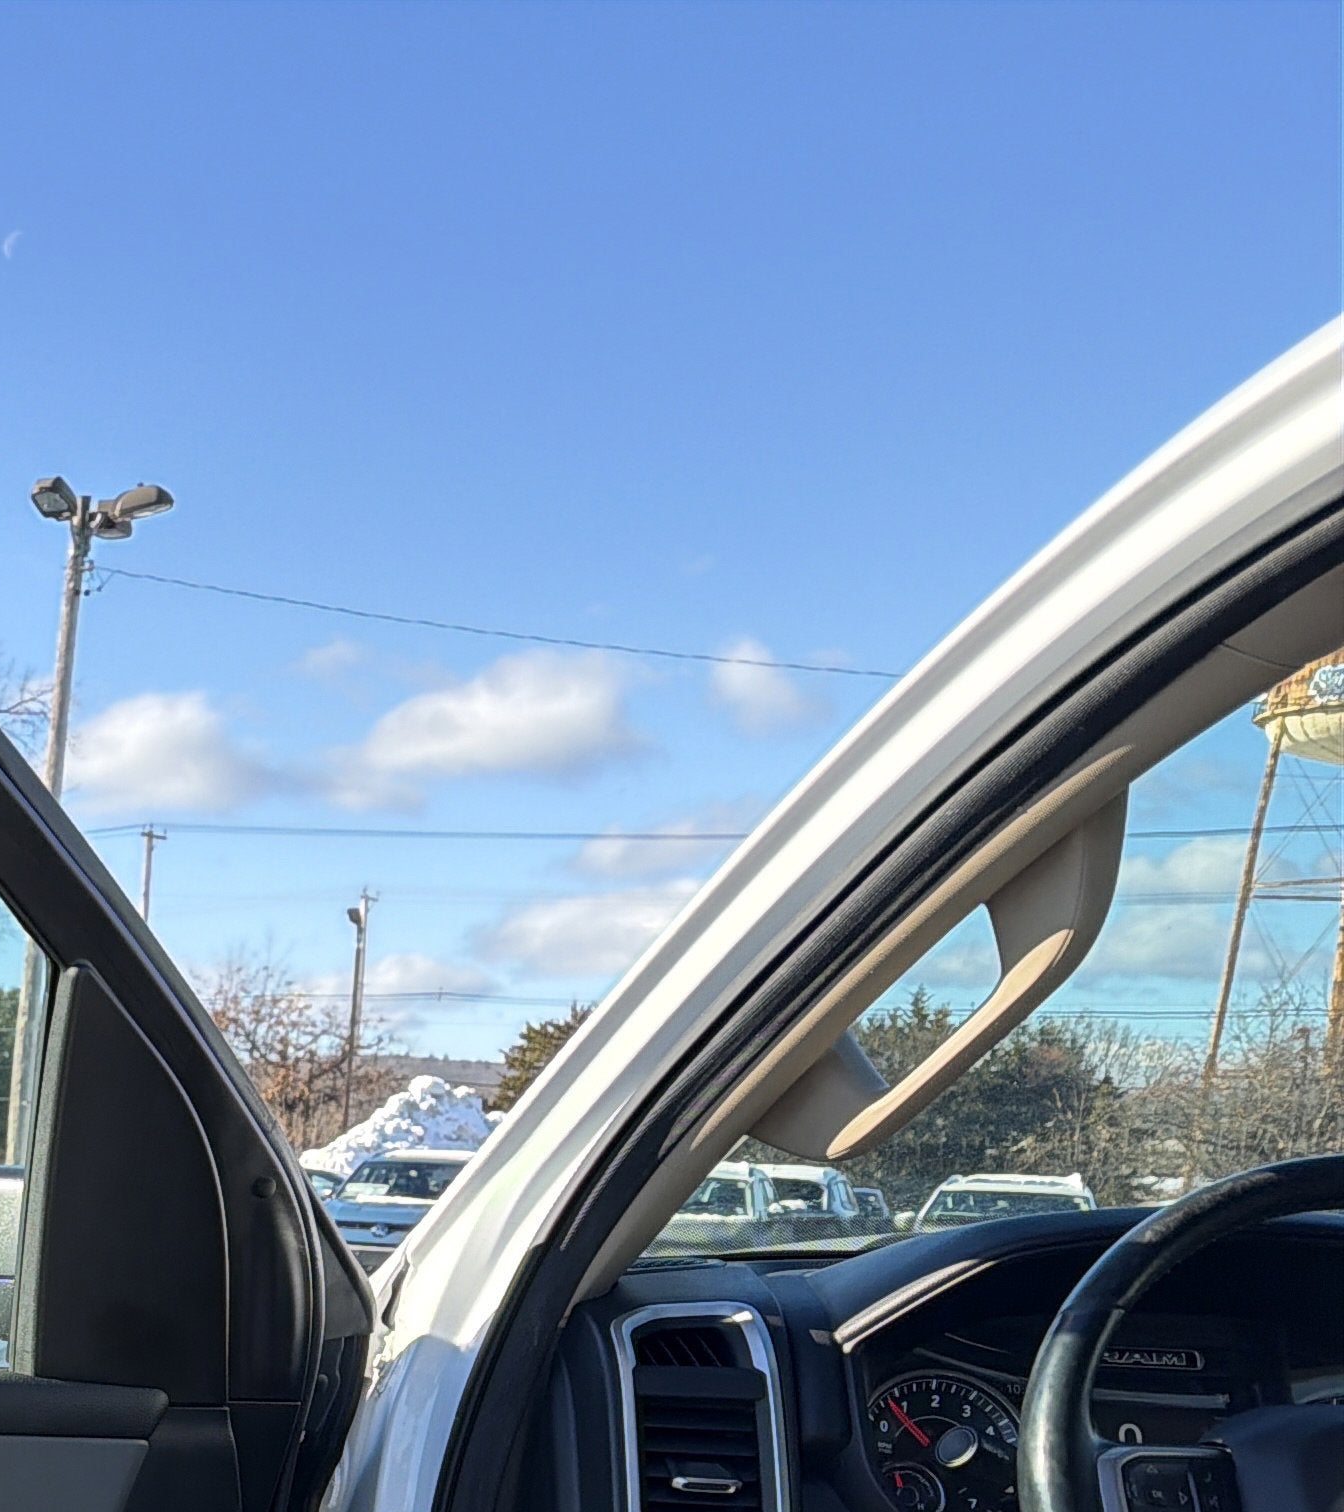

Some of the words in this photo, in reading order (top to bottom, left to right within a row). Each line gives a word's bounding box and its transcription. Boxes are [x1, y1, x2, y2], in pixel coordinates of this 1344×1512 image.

[901, 1401, 908, 1412] 1
[931, 1395, 940, 1407] 2
[962, 1405, 971, 1417] 3
[880, 1421, 888, 1432] 0
[986, 1425, 995, 1436] 4
[968, 1499, 977, 1509] 7
